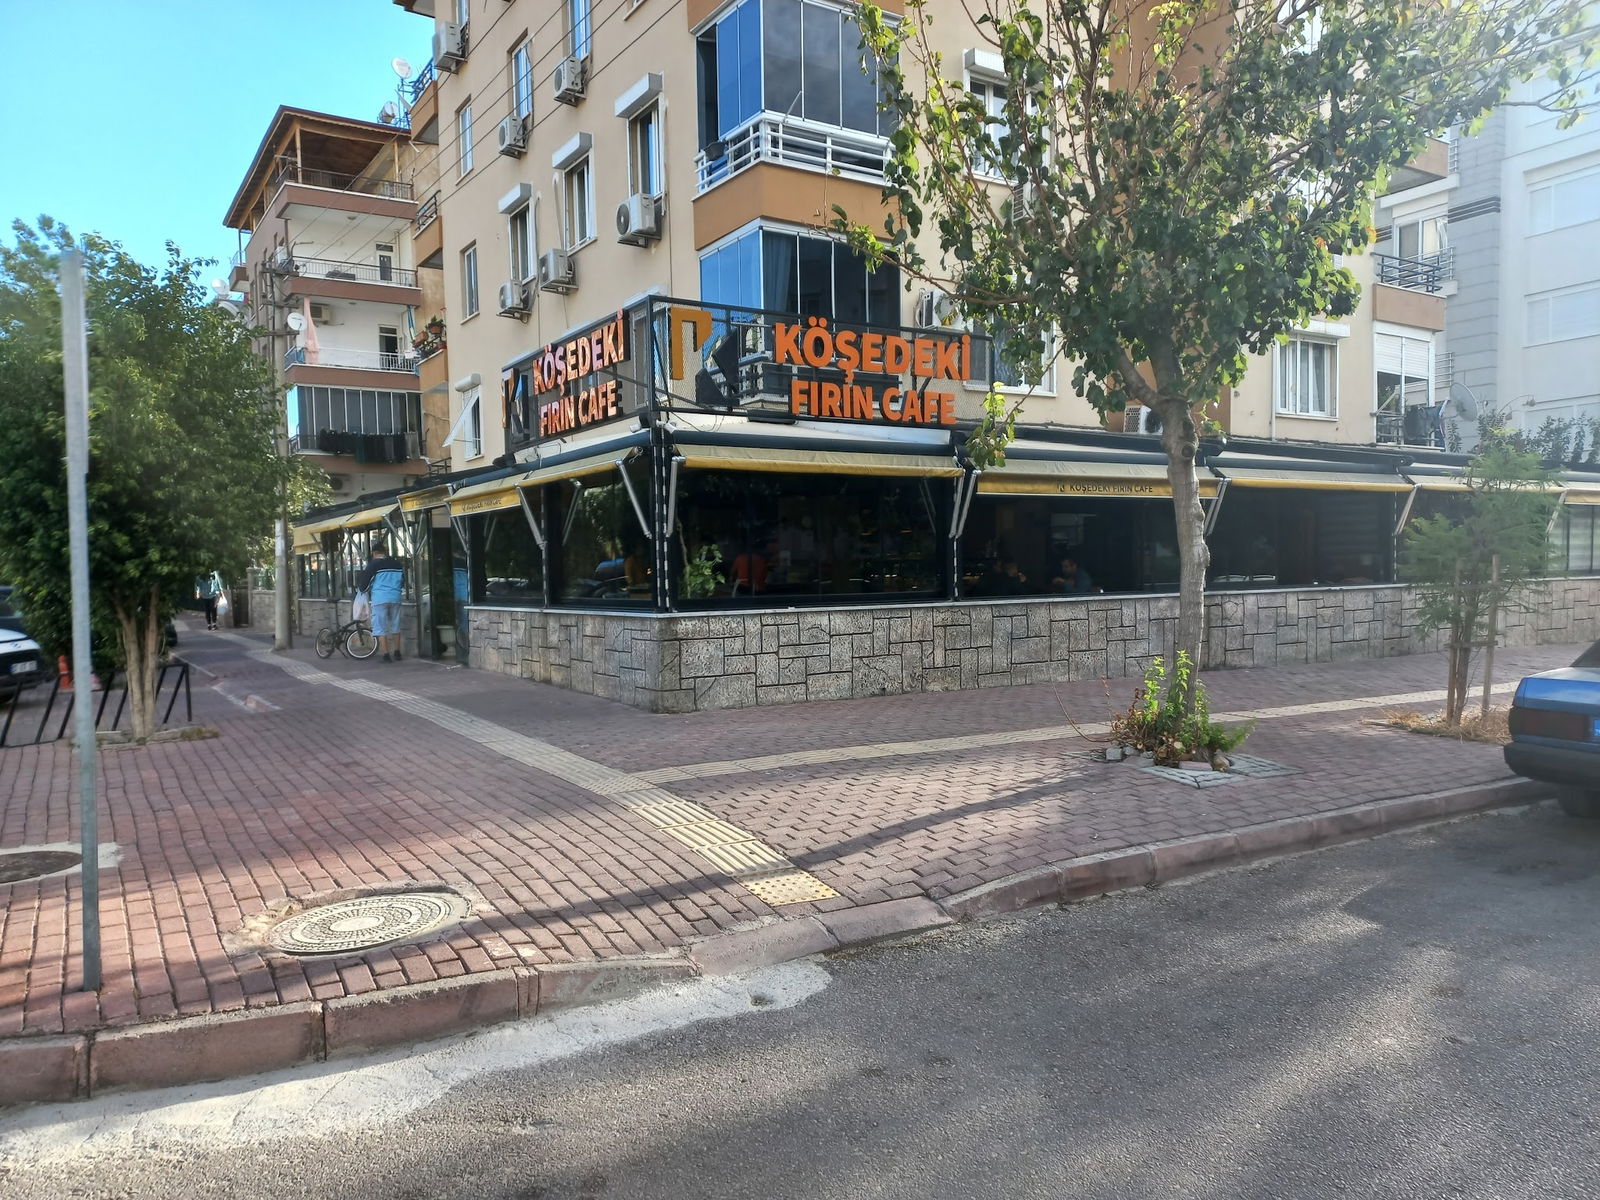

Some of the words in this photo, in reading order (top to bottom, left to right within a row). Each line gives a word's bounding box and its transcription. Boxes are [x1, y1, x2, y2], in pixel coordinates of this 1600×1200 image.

[532, 309, 625, 396] KÖŞEDEKİ
[774, 315, 971, 383] KÖŞEDEKİ
[539, 395, 576, 437] FIRIN
[578, 380, 617, 425] CAFE
[791, 380, 874, 420] FIRIN
[882, 387, 957, 424] CAFE
[1134, 485, 1153, 493] CAFE
